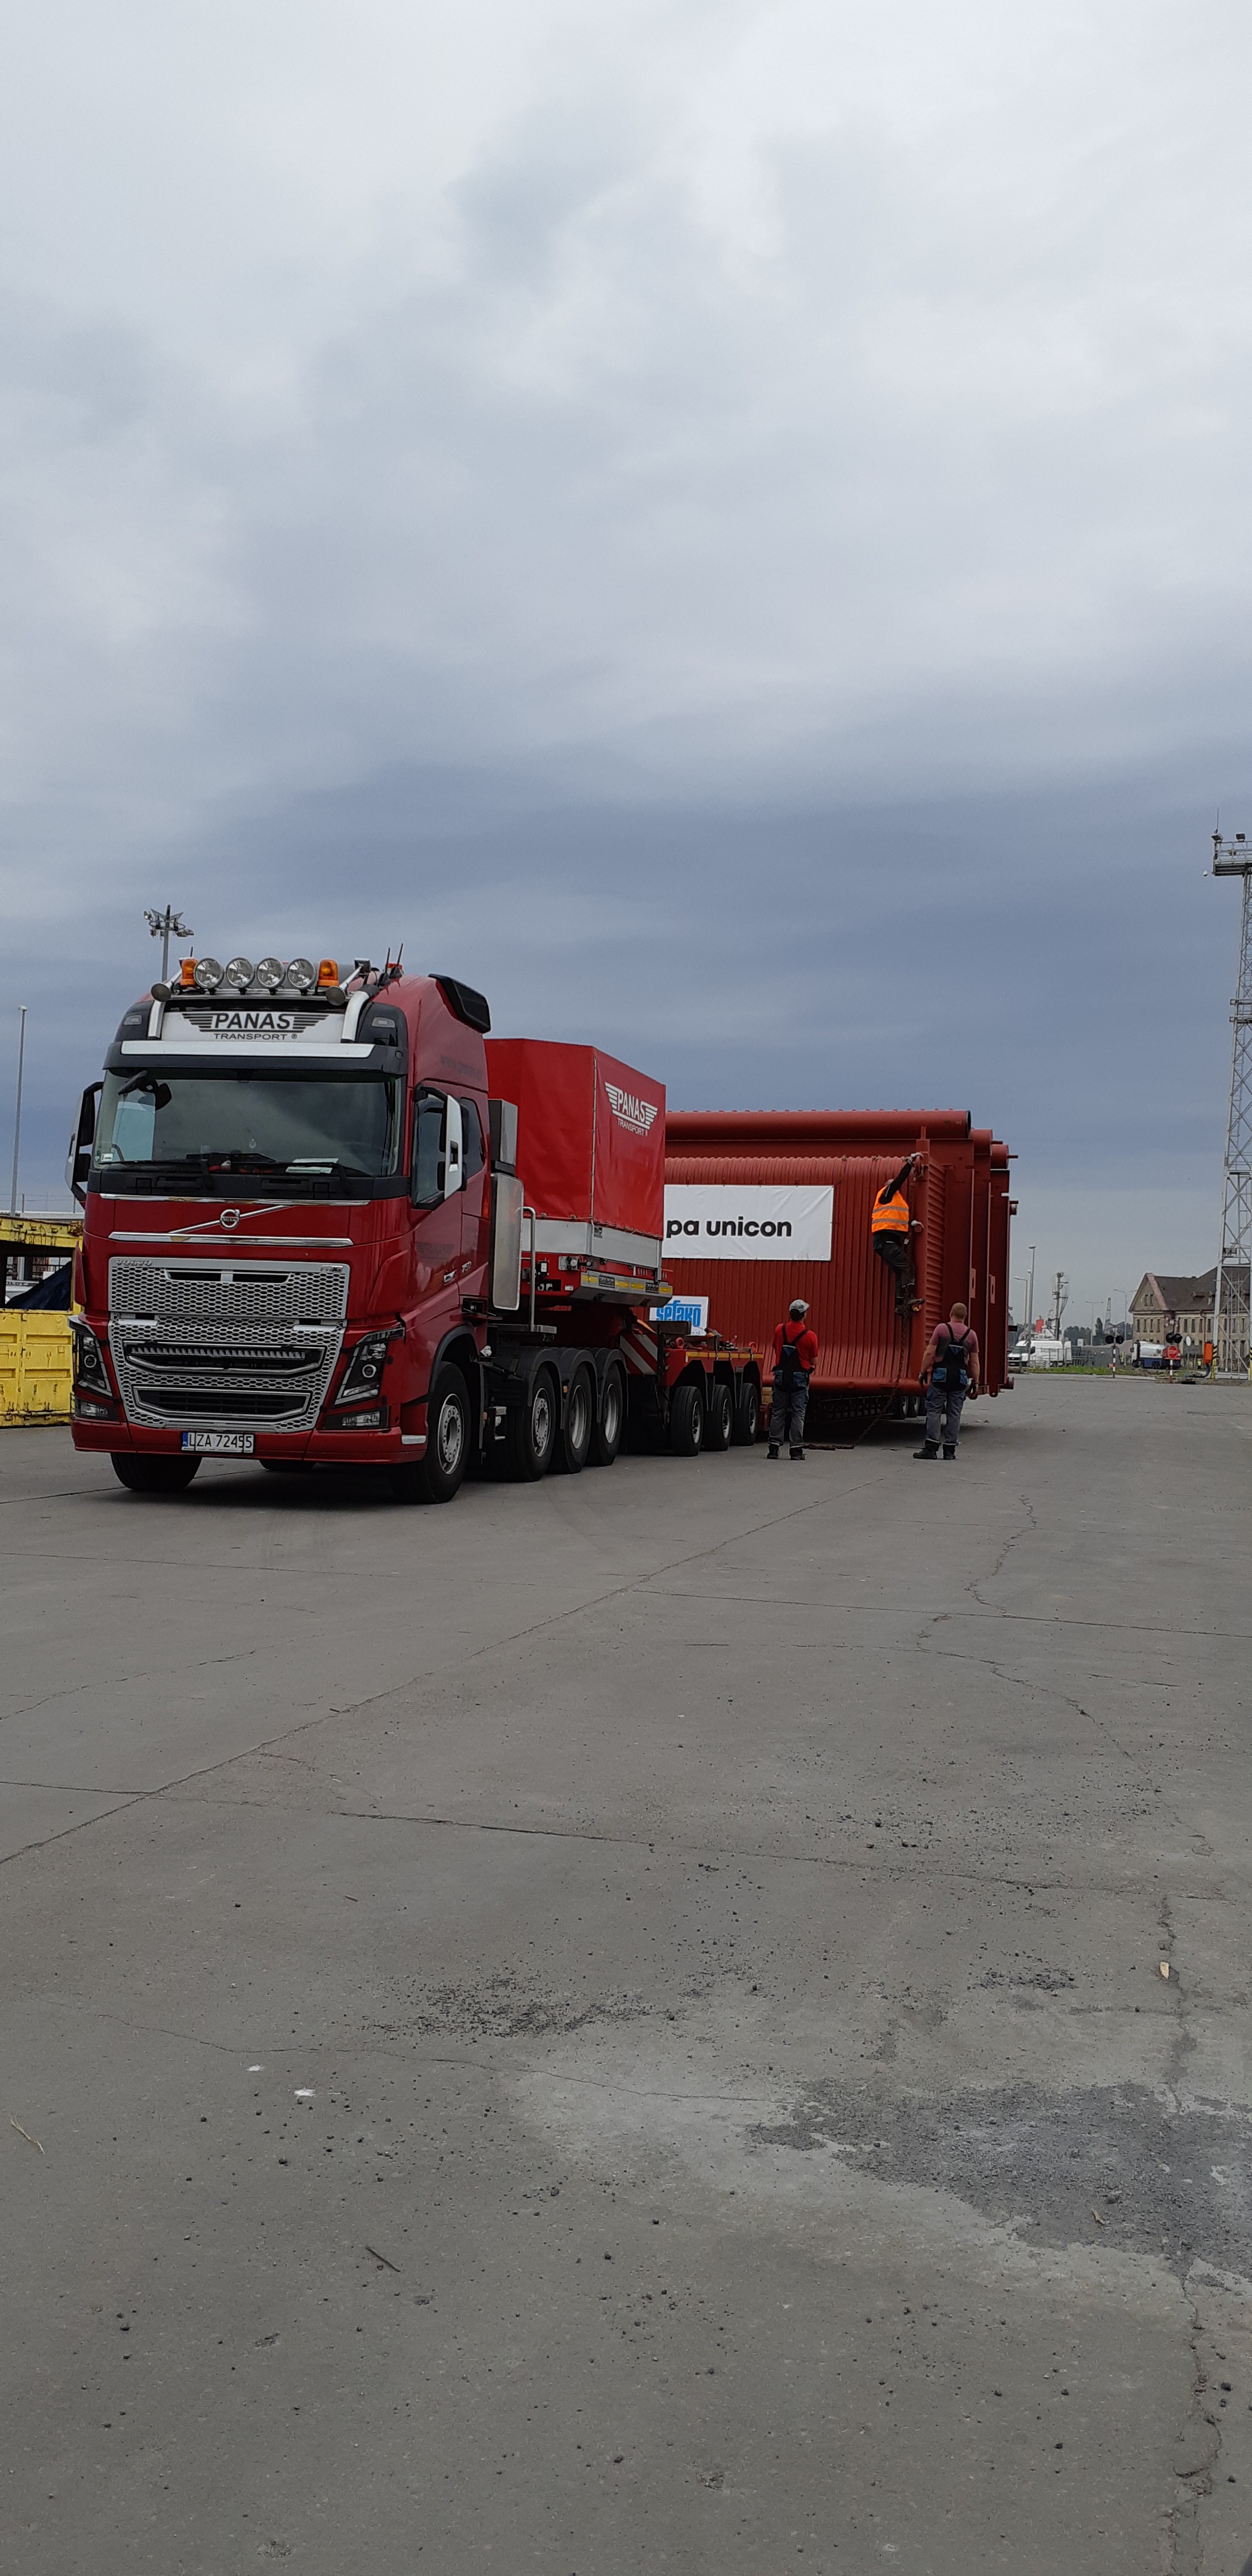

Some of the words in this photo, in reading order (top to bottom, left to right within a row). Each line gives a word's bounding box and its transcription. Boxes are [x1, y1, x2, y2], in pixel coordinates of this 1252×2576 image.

[214, 1012, 291, 1029] PANAS
[617, 1089, 646, 1123] PANAS
[617, 1117, 644, 1137] TRANSPORT
[706, 1216, 792, 1237] unicon
[189, 1433, 212, 1447] LZA
[216, 1434, 252, 1448] 72455
